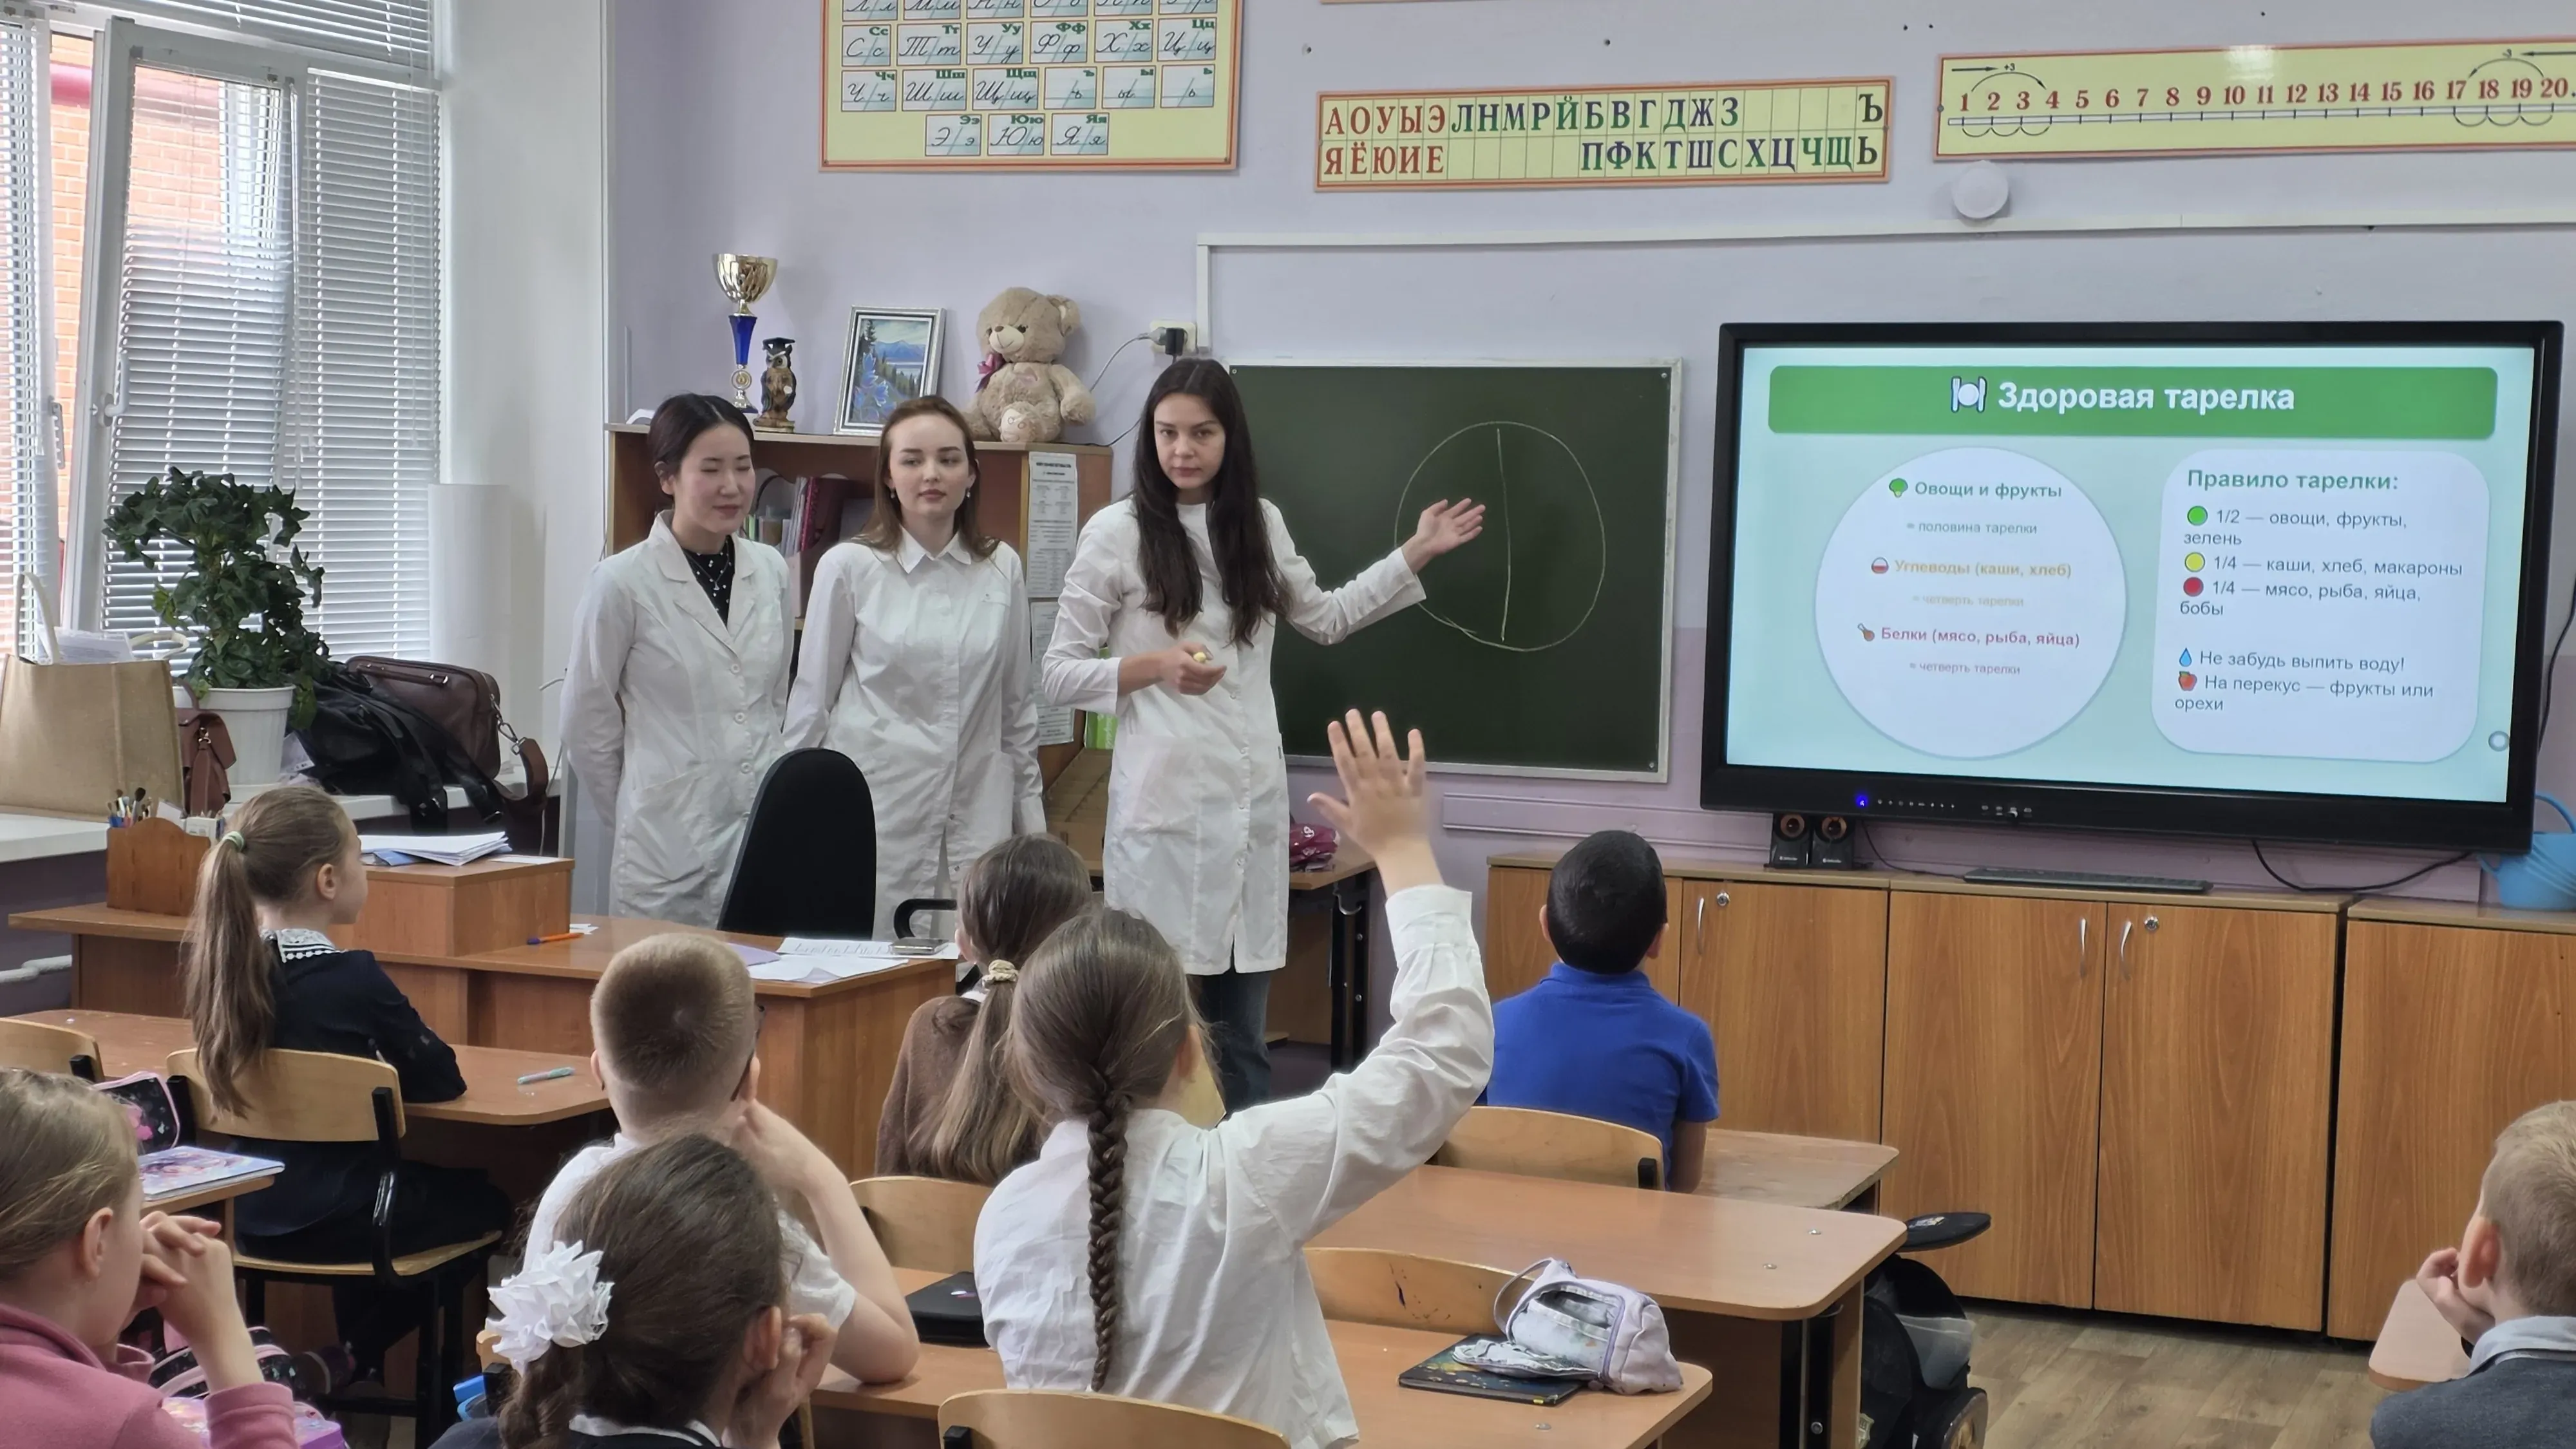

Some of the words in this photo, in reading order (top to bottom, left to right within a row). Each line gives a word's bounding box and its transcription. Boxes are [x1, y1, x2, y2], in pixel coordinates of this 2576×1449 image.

[1960, 93, 1969, 112] 1
[1988, 91, 2000, 112] 2
[2016, 91, 2031, 111] 3
[2045, 90, 2060, 109] 4
[2076, 90, 2089, 109] 5
[2105, 90, 2120, 109] 6
[2137, 88, 2149, 108] 7
[2166, 87, 2181, 106] 8
[2197, 86, 2211, 107] 9
[2224, 85, 2246, 106] 10
[2257, 85, 2273, 104] 11
[2286, 83, 2307, 103] 12
[2318, 83, 2340, 102] 13
[2349, 82, 2371, 102] 14
[2382, 81, 2403, 102] 15
[2413, 80, 2434, 100] 16
[2447, 80, 2467, 100] 17
[2479, 78, 2500, 100] 18
[2511, 78, 2533, 99] 19
[2540, 77, 2568, 99] 20
[1998, 381, 2154, 415] Здоровая
[2164, 388, 2295, 415] тарелка
[1915, 481, 1974, 498] Овощи
[1979, 486, 1989, 496] и
[1995, 482, 2062, 500] фрукты
[2188, 469, 2289, 491] Правило
[2296, 475, 2398, 493] тарелки:
[1918, 523, 1981, 533] половина
[1985, 524, 2037, 536] тарелки
[2217, 509, 2240, 524] 1/2
[2269, 513, 2329, 527] овощи,
[2336, 511, 2407, 529] фрукты,
[2184, 533, 2242, 545] зелень
[1895, 560, 1970, 575] Углеводы
[1975, 562, 2023, 577] (каши,
[2029, 564, 2072, 580] хлеб)
[2214, 556, 2237, 570] 1/4
[2267, 560, 2315, 574] каши,
[2322, 558, 2367, 575] хлеб,
[2374, 562, 2462, 578] макароны
[2213, 580, 2235, 594] 1/4
[2266, 585, 2312, 599] мясо,
[2318, 583, 2367, 601] рыба,
[2374, 585, 2420, 602] яйца,
[2180, 600, 2224, 616] бобы
[1881, 627, 1927, 641] Белки
[1932, 629, 1980, 644] (мясо,
[1985, 630, 2031, 646] рыба,
[2036, 632, 2079, 649] яйца)
[1919, 663, 1971, 674] четверть
[1975, 665, 2020, 675] тарелки
[2200, 650, 2222, 665] Не
[2228, 652, 2286, 670] забудь
[2291, 657, 2354, 670] выпить
[2360, 657, 2405, 675] воду!
[2205, 674, 2227, 690] На
[2233, 679, 2300, 696] перекус
[2329, 679, 2395, 698] фрукты
[2401, 686, 2433, 697] или
[2175, 698, 2223, 713] орехи
